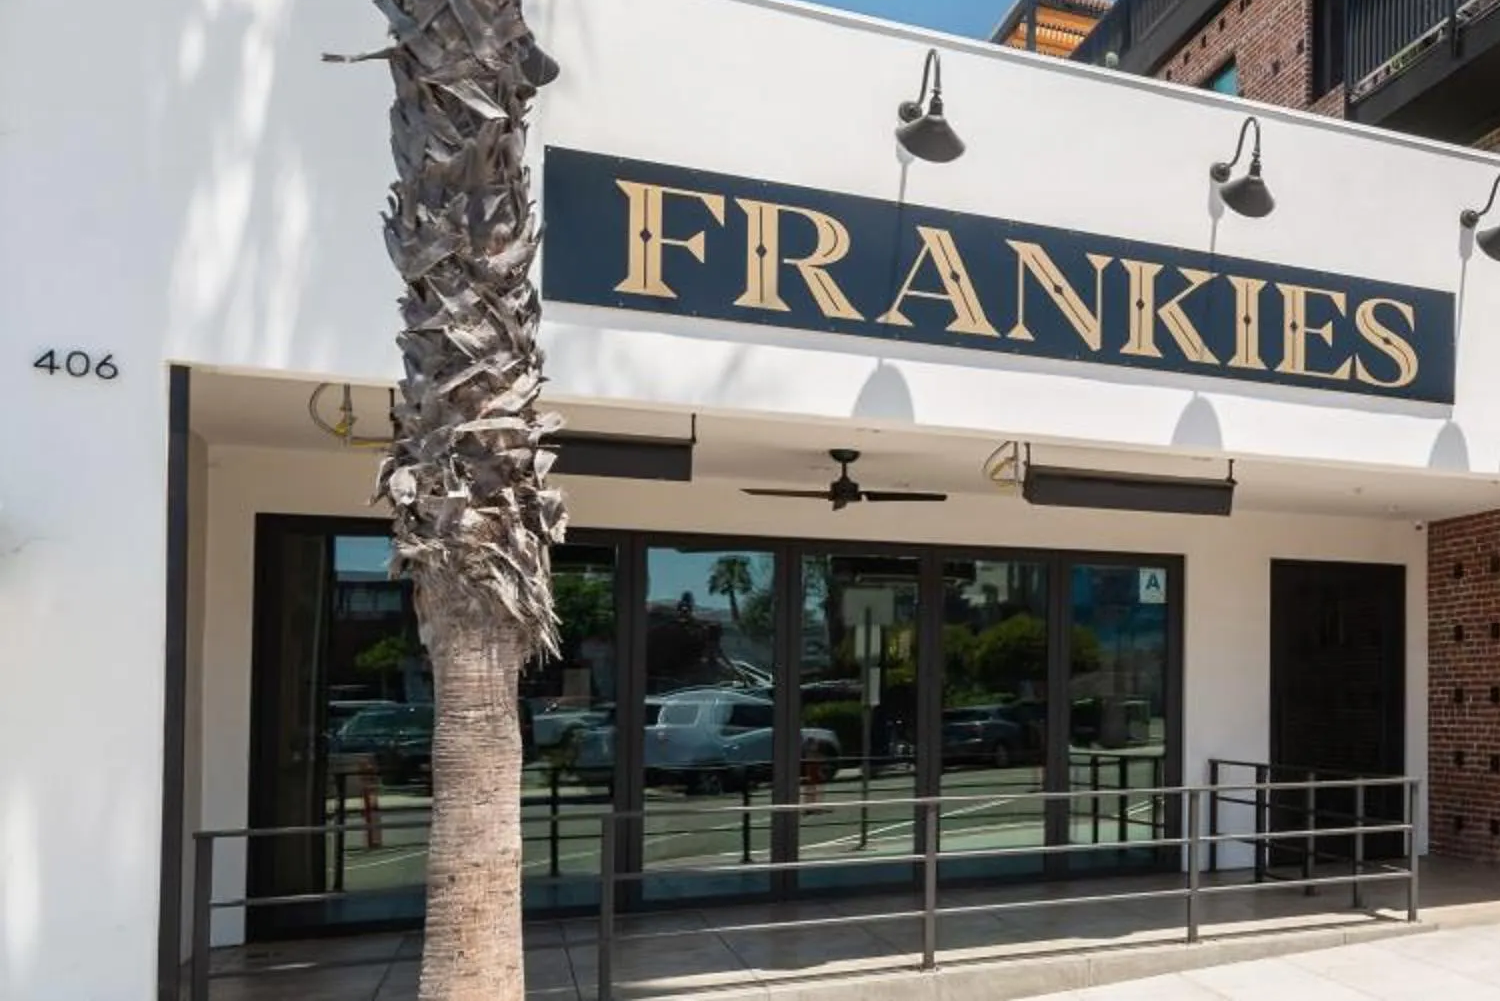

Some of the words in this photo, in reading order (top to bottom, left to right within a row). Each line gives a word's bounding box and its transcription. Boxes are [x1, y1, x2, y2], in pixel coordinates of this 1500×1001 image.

[614, 177, 1419, 389] FRANKIES
[33, 349, 119, 380] 406
[1145, 573, 1161, 590] A
